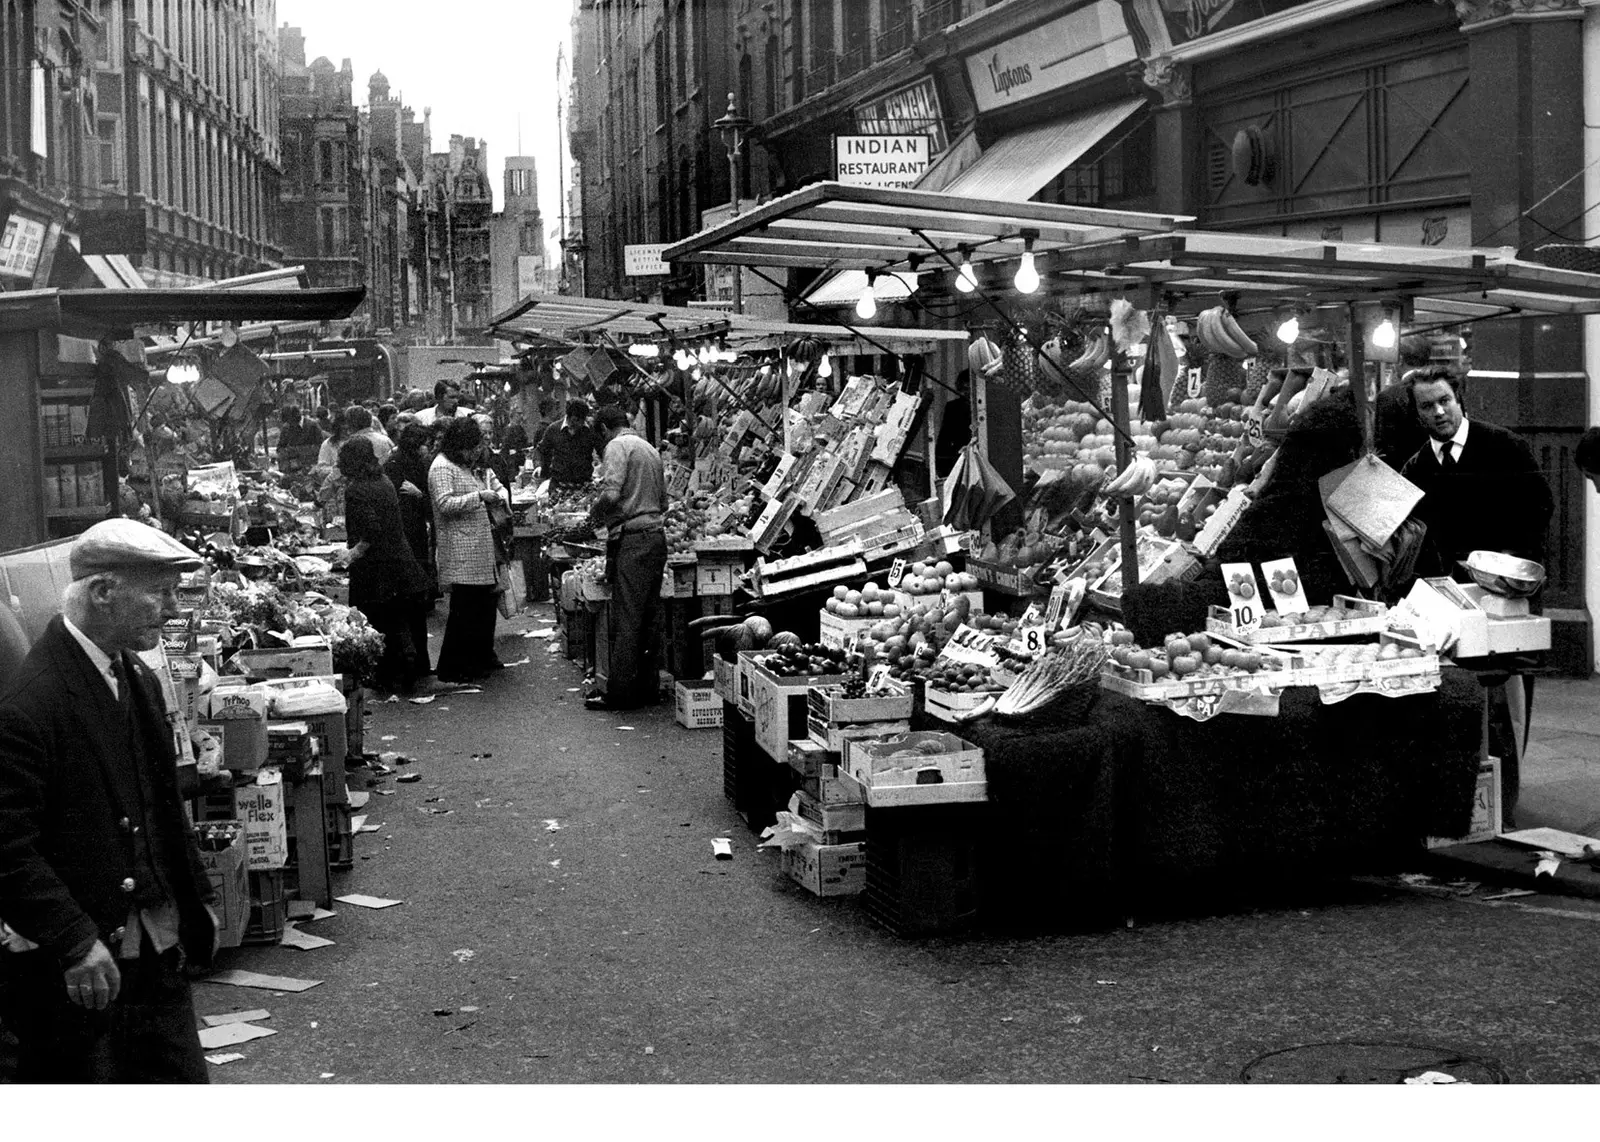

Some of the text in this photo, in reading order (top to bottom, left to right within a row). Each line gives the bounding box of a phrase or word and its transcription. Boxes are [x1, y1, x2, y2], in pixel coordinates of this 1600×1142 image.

[988, 53, 1032, 96] Liptons
[847, 139, 917, 154] INDIAN
[839, 161, 926, 175] RESTAURANT
[1249, 418, 1260, 438] 25
[890, 562, 902, 577] 15
[171, 660, 199, 671] Delsey
[238, 794, 272, 811] wella
